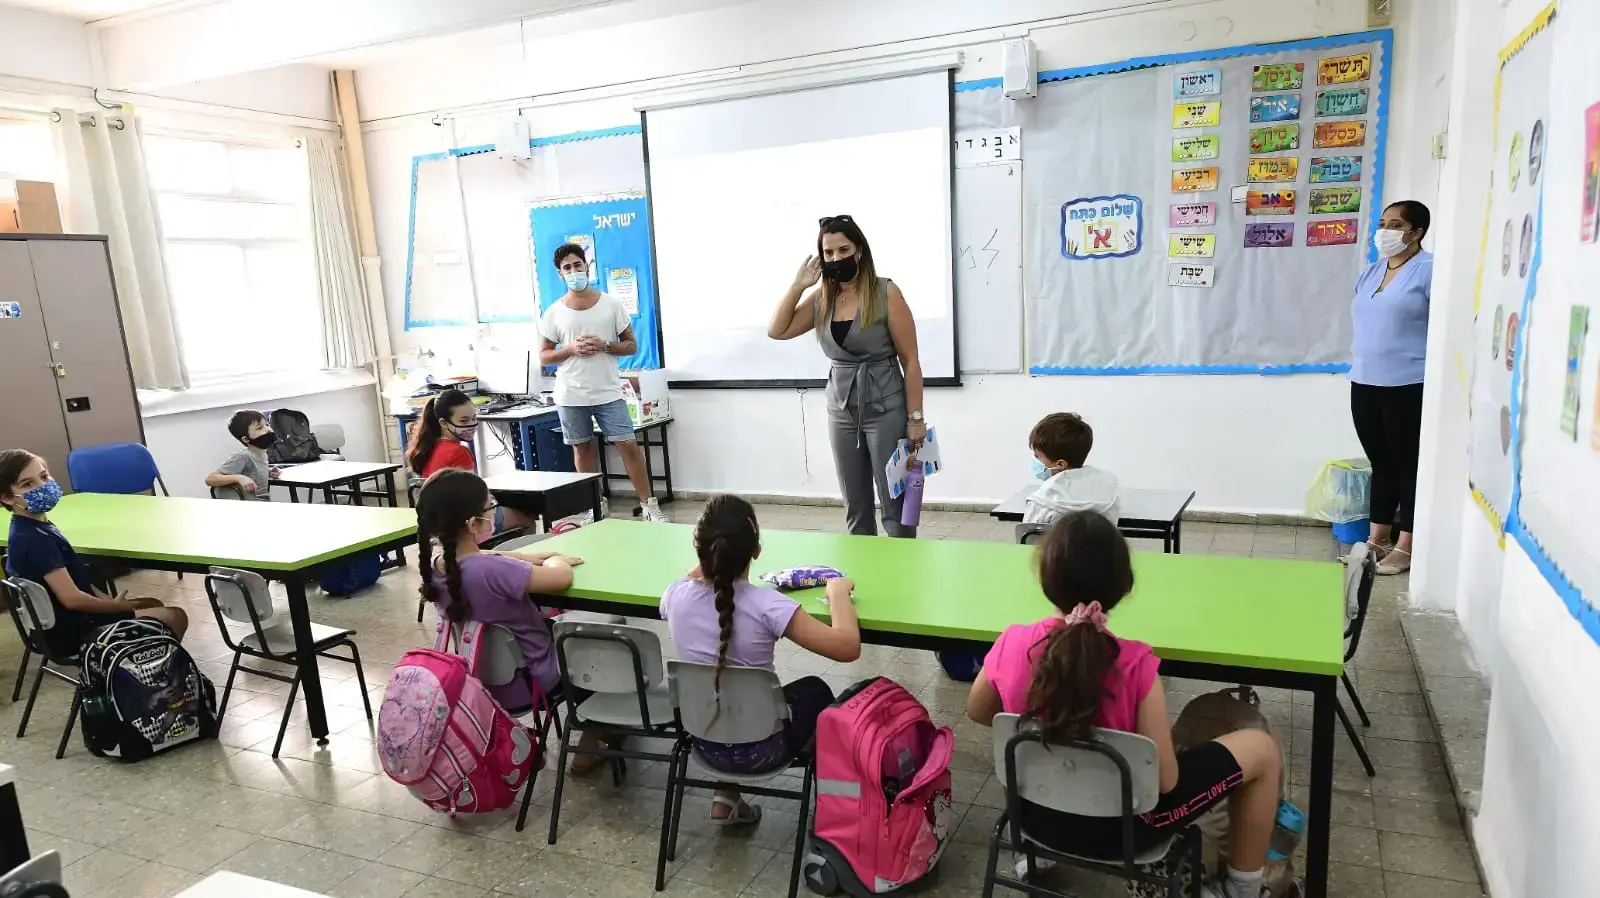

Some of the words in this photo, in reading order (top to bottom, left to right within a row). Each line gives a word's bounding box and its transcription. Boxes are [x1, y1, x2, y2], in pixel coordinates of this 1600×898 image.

[593, 212, 636, 229] ישראל
[1207, 779, 1228, 800] LOVE
[1168, 803, 1190, 822] LOVE
